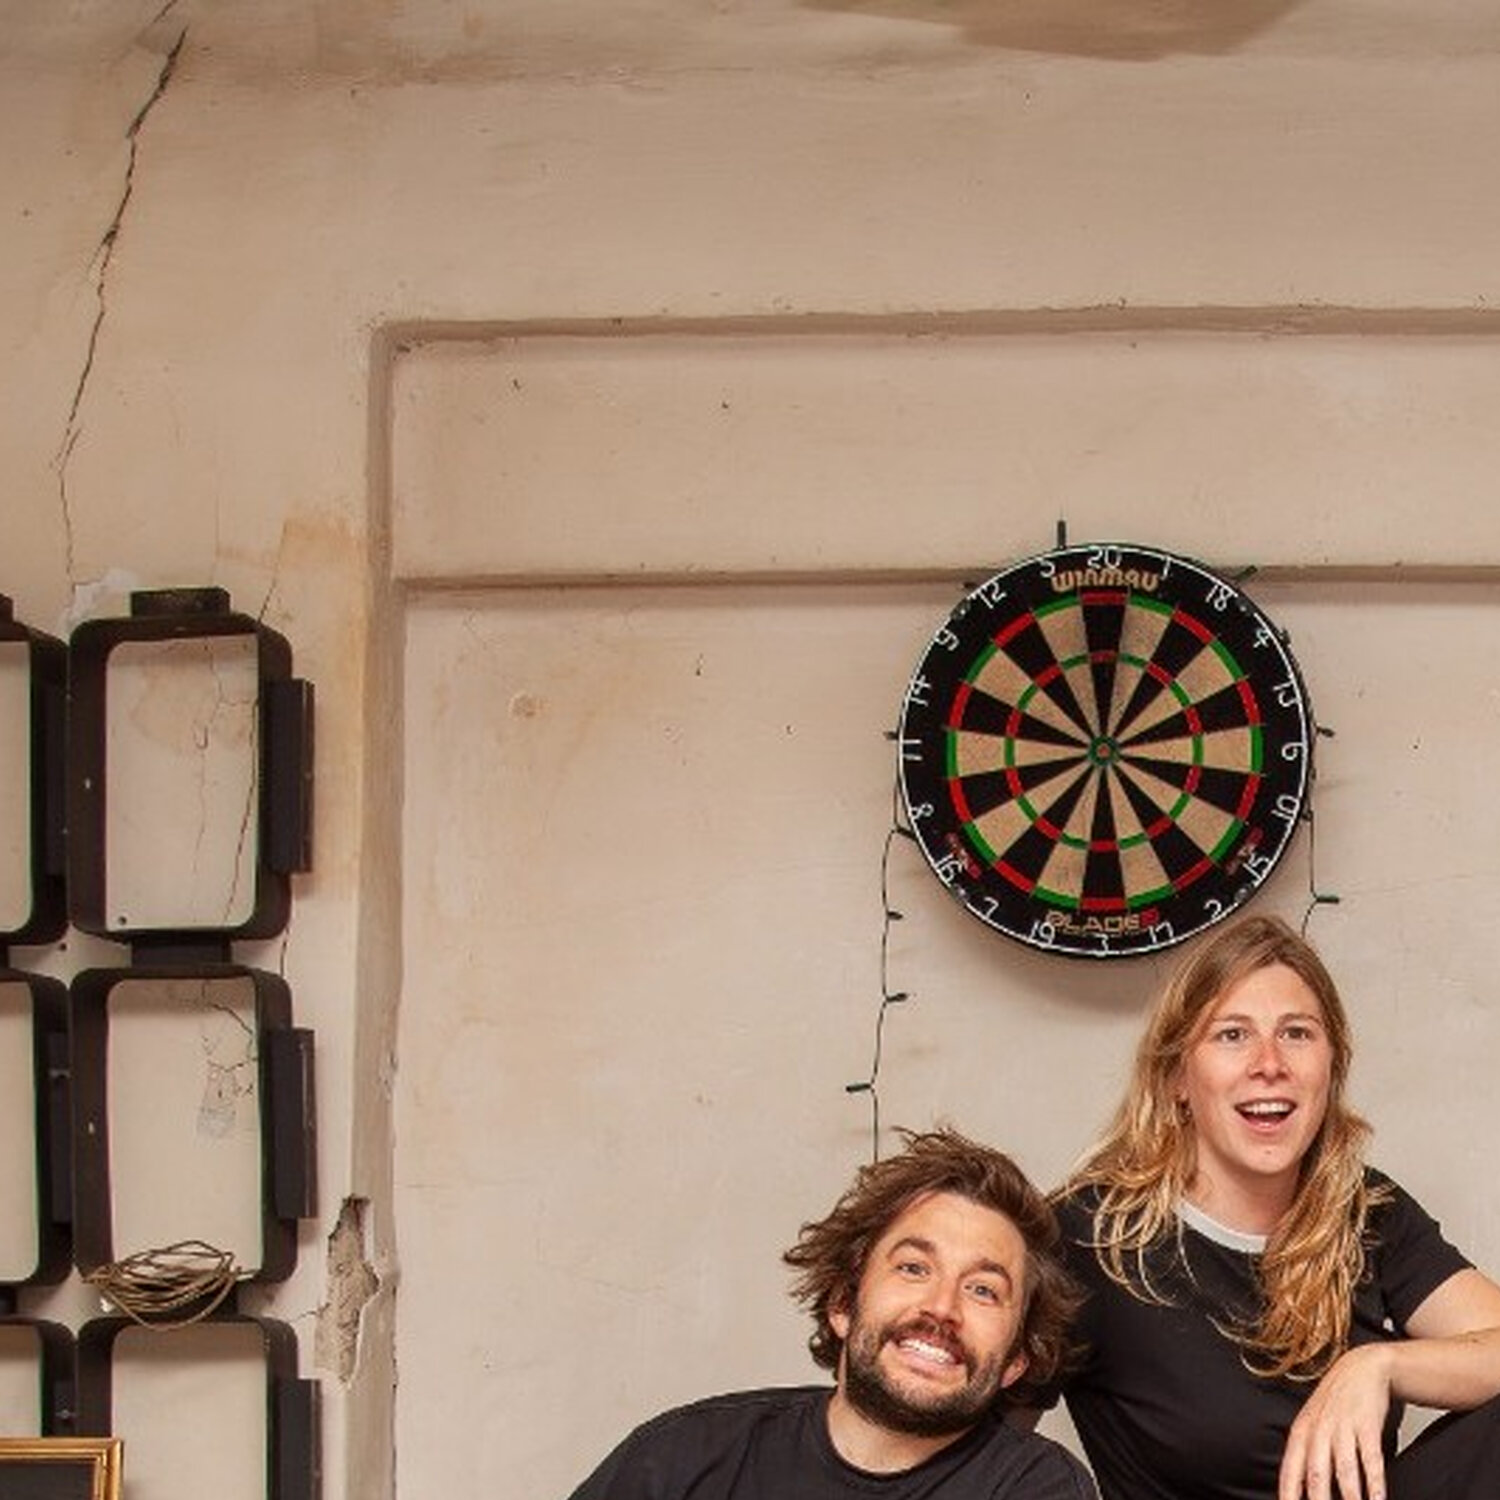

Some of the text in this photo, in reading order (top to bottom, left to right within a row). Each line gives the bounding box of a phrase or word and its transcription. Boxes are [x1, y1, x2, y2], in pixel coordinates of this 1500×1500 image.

[1038, 557, 1056, 578] 5
[1087, 545, 1121, 570] 20
[1160, 555, 1172, 580] 1
[974, 581, 1007, 610] 12
[1205, 583, 1234, 612] 18
[934, 627, 960, 652] 9
[1252, 627, 1273, 649] 4
[908, 674, 932, 707] 14
[1272, 680, 1300, 708] 13
[902, 738, 923, 761] 11
[1281, 741, 1306, 762] 6
[909, 802, 934, 821] 8
[1270, 795, 1301, 821] 10
[936, 853, 964, 883] 16
[1242, 853, 1272, 885] 15
[983, 896, 999, 922] 7
[1203, 899, 1222, 922] 2
[1030, 920, 1056, 947] 19
[1087, 932, 1110, 956] 3
[1147, 921, 1174, 947] 17
